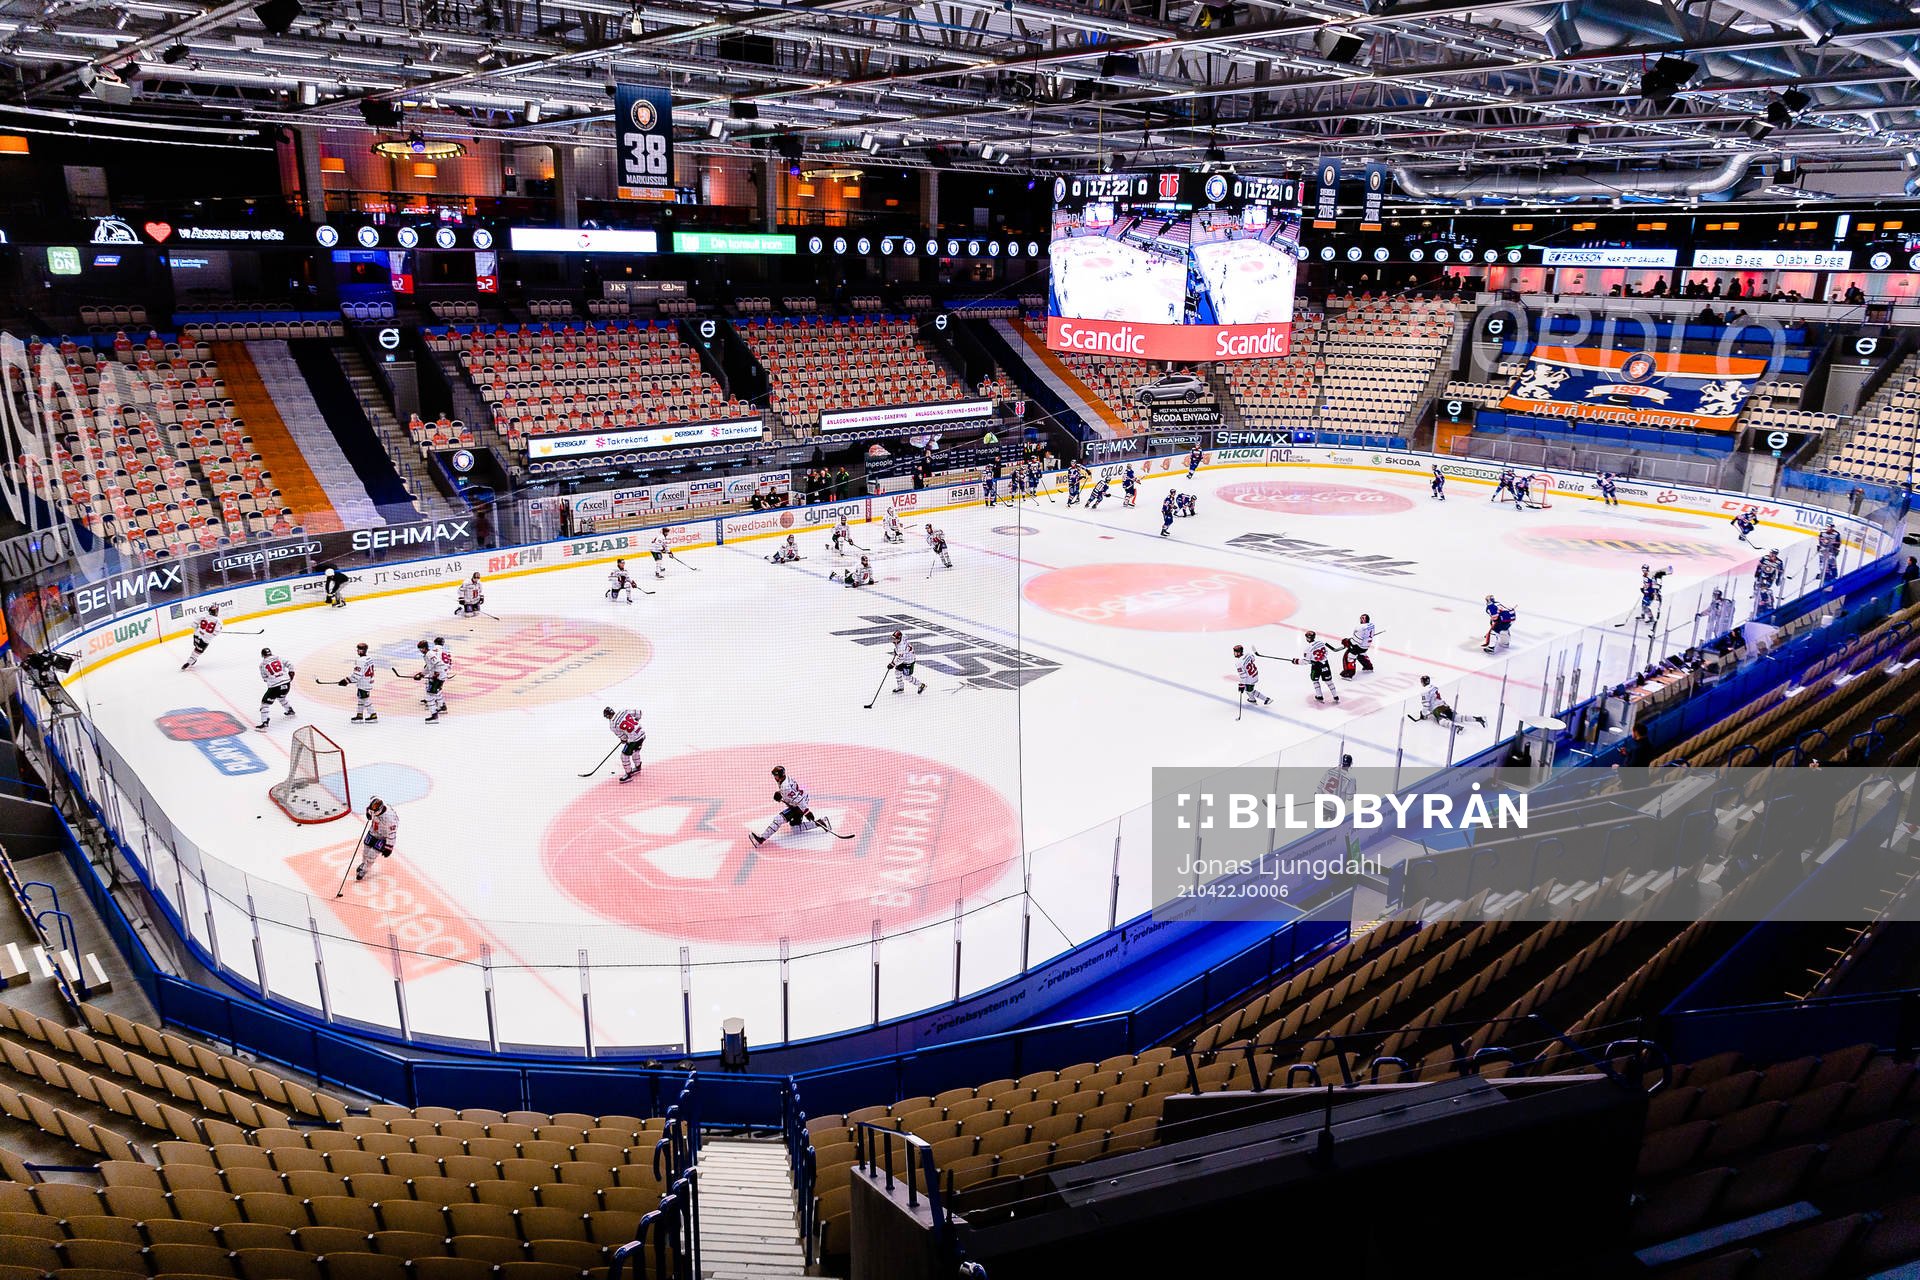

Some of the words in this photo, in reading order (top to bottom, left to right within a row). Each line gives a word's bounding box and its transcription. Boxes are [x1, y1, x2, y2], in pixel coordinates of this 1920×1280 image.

[624, 132, 667, 174] 38
[626, 174, 668, 186] MARKUSSON
[1072, 181, 1081, 196] 0
[1090, 180, 1128, 196] 17:22
[1138, 180, 1148, 195] 0
[1234, 182, 1242, 197] 0
[1248, 182, 1280, 200] 17:22
[1285, 186, 1294, 200] 0
[1059, 323, 1145, 354] Scandic
[1216, 327, 1284, 356] Scandic
[1612, 384, 1650, 397] 1997
[1152, 412, 1182, 422] ŠKODA
[1182, 413, 1210, 422] ENYAQ
[1217, 431, 1288, 445] SEHMAX
[866, 458, 894, 469] Inpeople
[1270, 449, 1292, 463] ALT
[1385, 456, 1421, 467] ŠKODA
[760, 472, 790, 482] öman
[1101, 465, 1124, 478] case
[1441, 464, 1503, 480] CASHBUDDY
[614, 488, 650, 500] öman
[690, 481, 722, 492] öman
[734, 482, 756, 492] Axcell
[952, 488, 976, 498] RSAB
[1558, 480, 1584, 492] Bixia
[662, 490, 685, 502] Axcell
[892, 494, 918, 508] VEAB
[582, 500, 608, 512] Axcell
[804, 504, 860, 525] dynacon
[727, 517, 778, 534] Swedbank
[352, 521, 470, 551] SEHMAX
[572, 536, 630, 556] PEAB
[218, 552, 264, 570] ULTRA
[488, 546, 543, 573] RIXFM
[373, 572, 390, 586] JT
[393, 566, 442, 582] Sanering
[445, 561, 462, 573] AB
[77, 564, 182, 614] SEHMAX
[293, 574, 363, 592] FORTOX
[184, 606, 198, 618] ITK
[88, 618, 152, 655] SUBWAY
[870, 772, 941, 907] BAUHAUS
[1047, 953, 1104, 989] prefabsystem
[936, 994, 1010, 1034] prefabsystem
[1010, 988, 1026, 1008] syd
